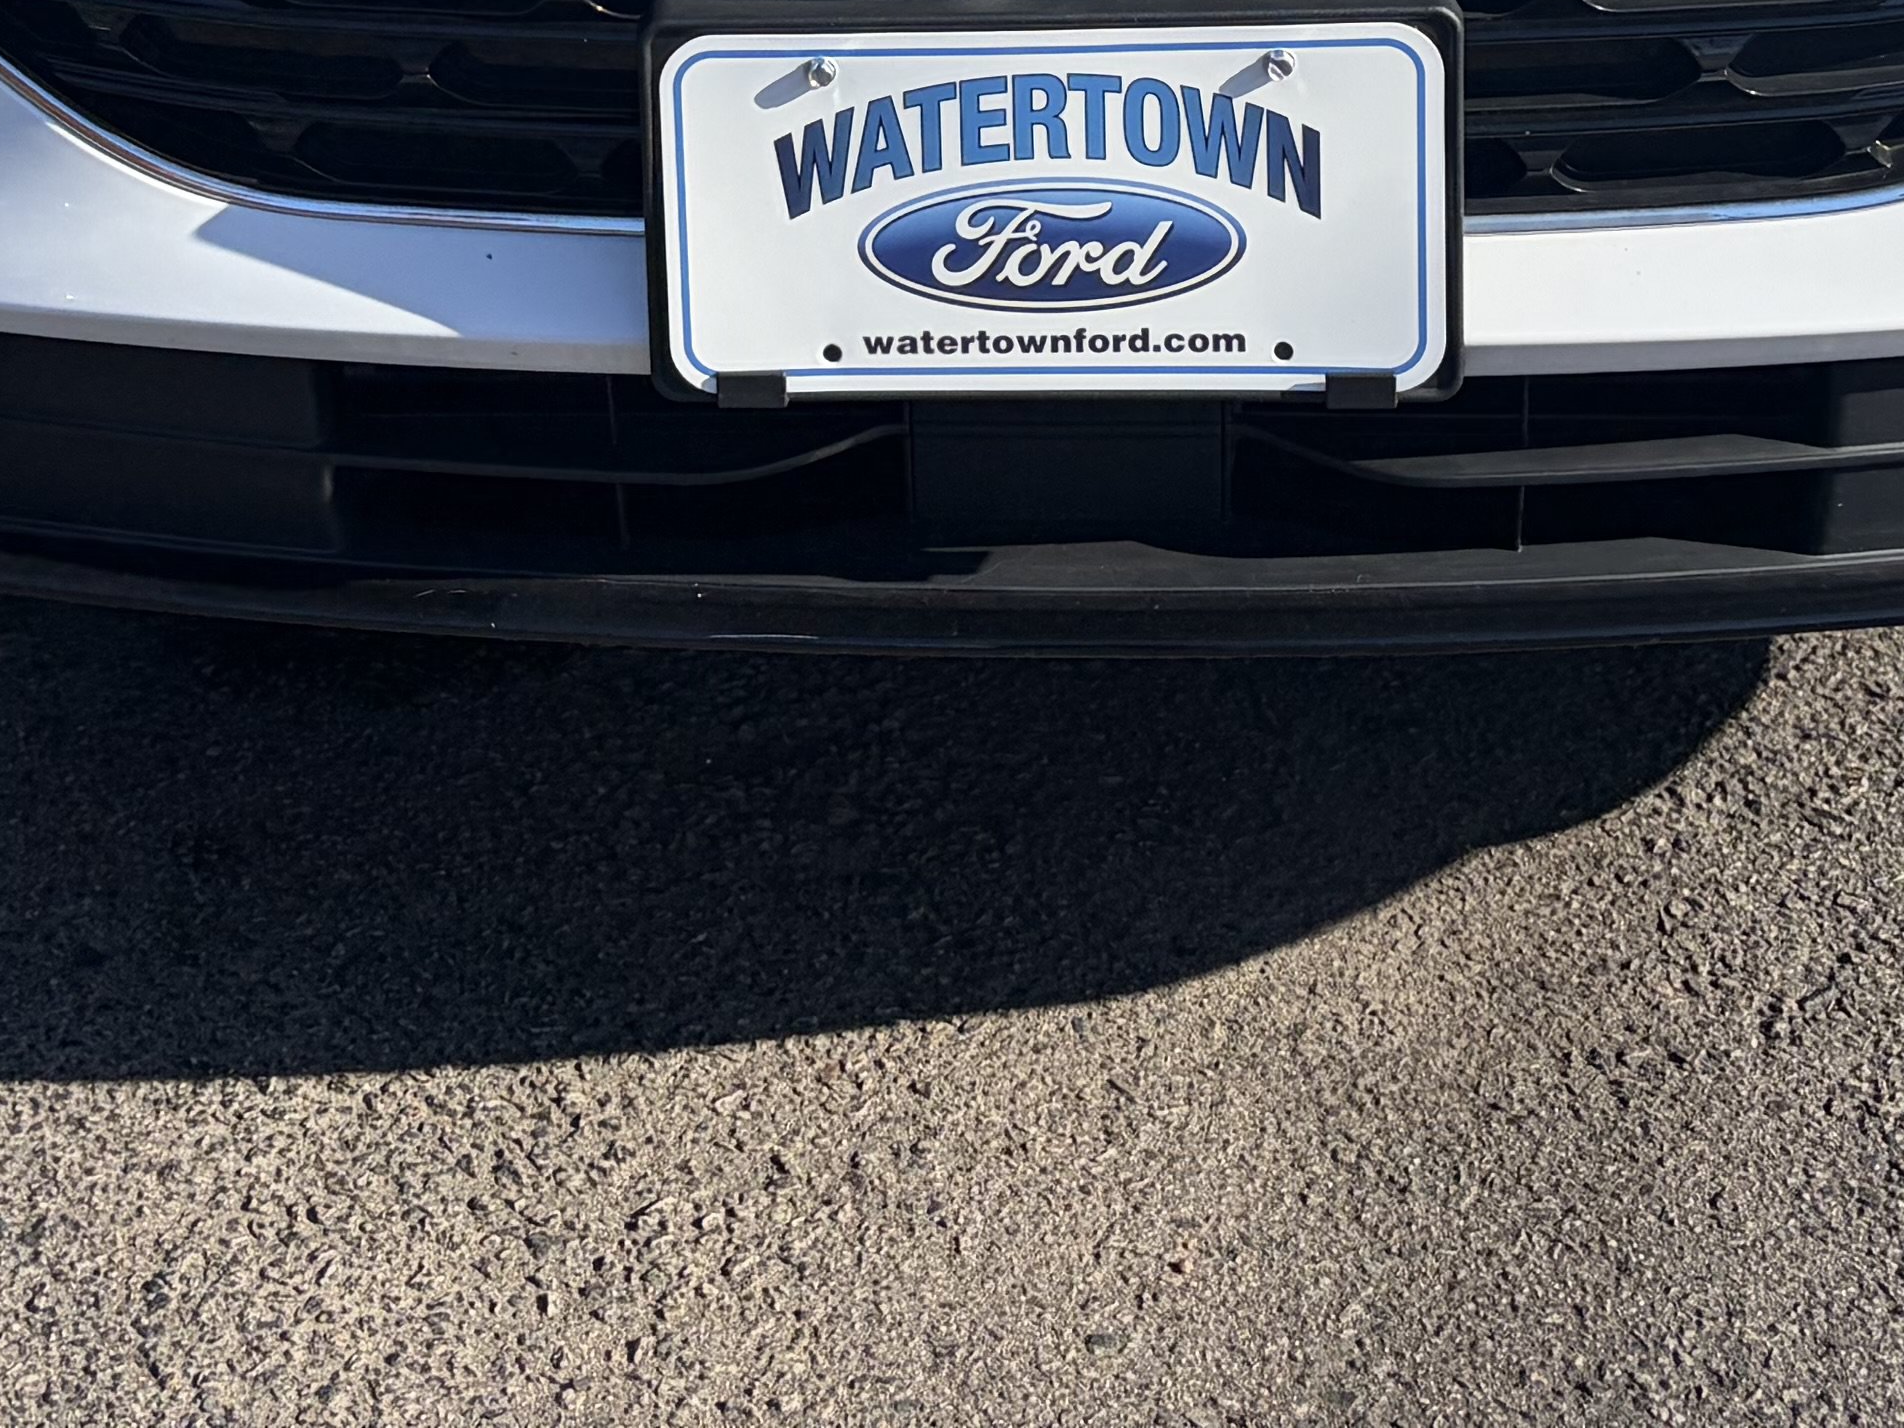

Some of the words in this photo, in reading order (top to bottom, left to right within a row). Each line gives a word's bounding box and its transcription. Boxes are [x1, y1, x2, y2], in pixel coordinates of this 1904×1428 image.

[772, 72, 1322, 221] WATERTOWN
[930, 197, 1176, 288] Ford
[862, 328, 1247, 356] watertownford.com
